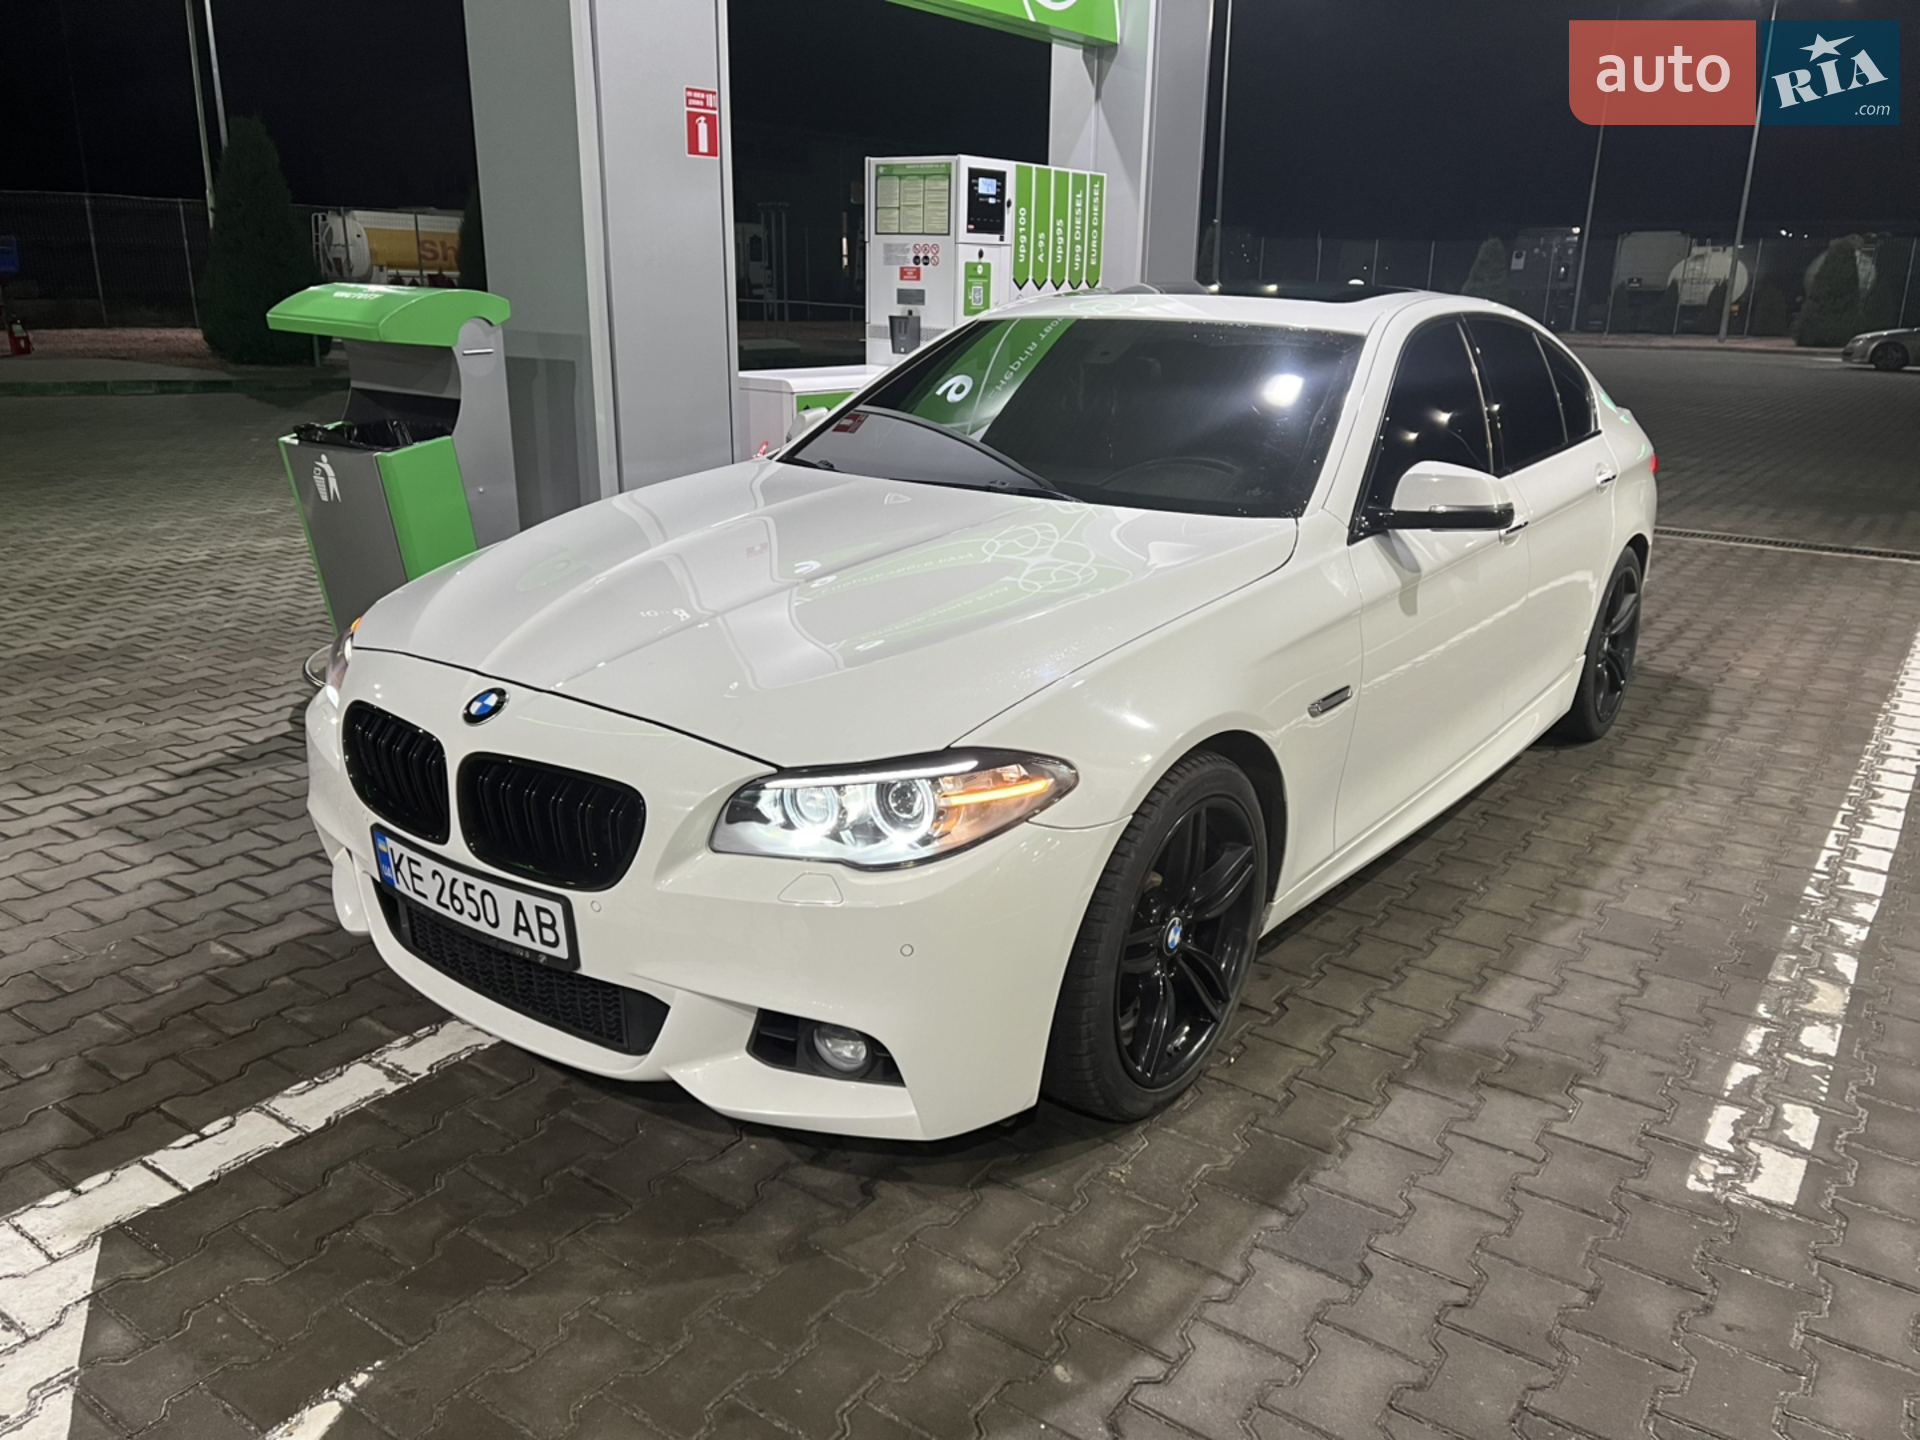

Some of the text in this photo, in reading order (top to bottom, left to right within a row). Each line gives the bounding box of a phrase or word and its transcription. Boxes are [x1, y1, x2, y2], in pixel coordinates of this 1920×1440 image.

[1074, 189, 1083, 240] DIESEL
[1090, 180, 1100, 265] EURO DIESEL
[1037, 232, 1046, 263] A-95
[1055, 219, 1064, 263] upg95
[382, 864, 393, 878] UA
[390, 847, 428, 900] KE
[431, 869, 500, 929] 2650
[513, 900, 560, 949] AB
